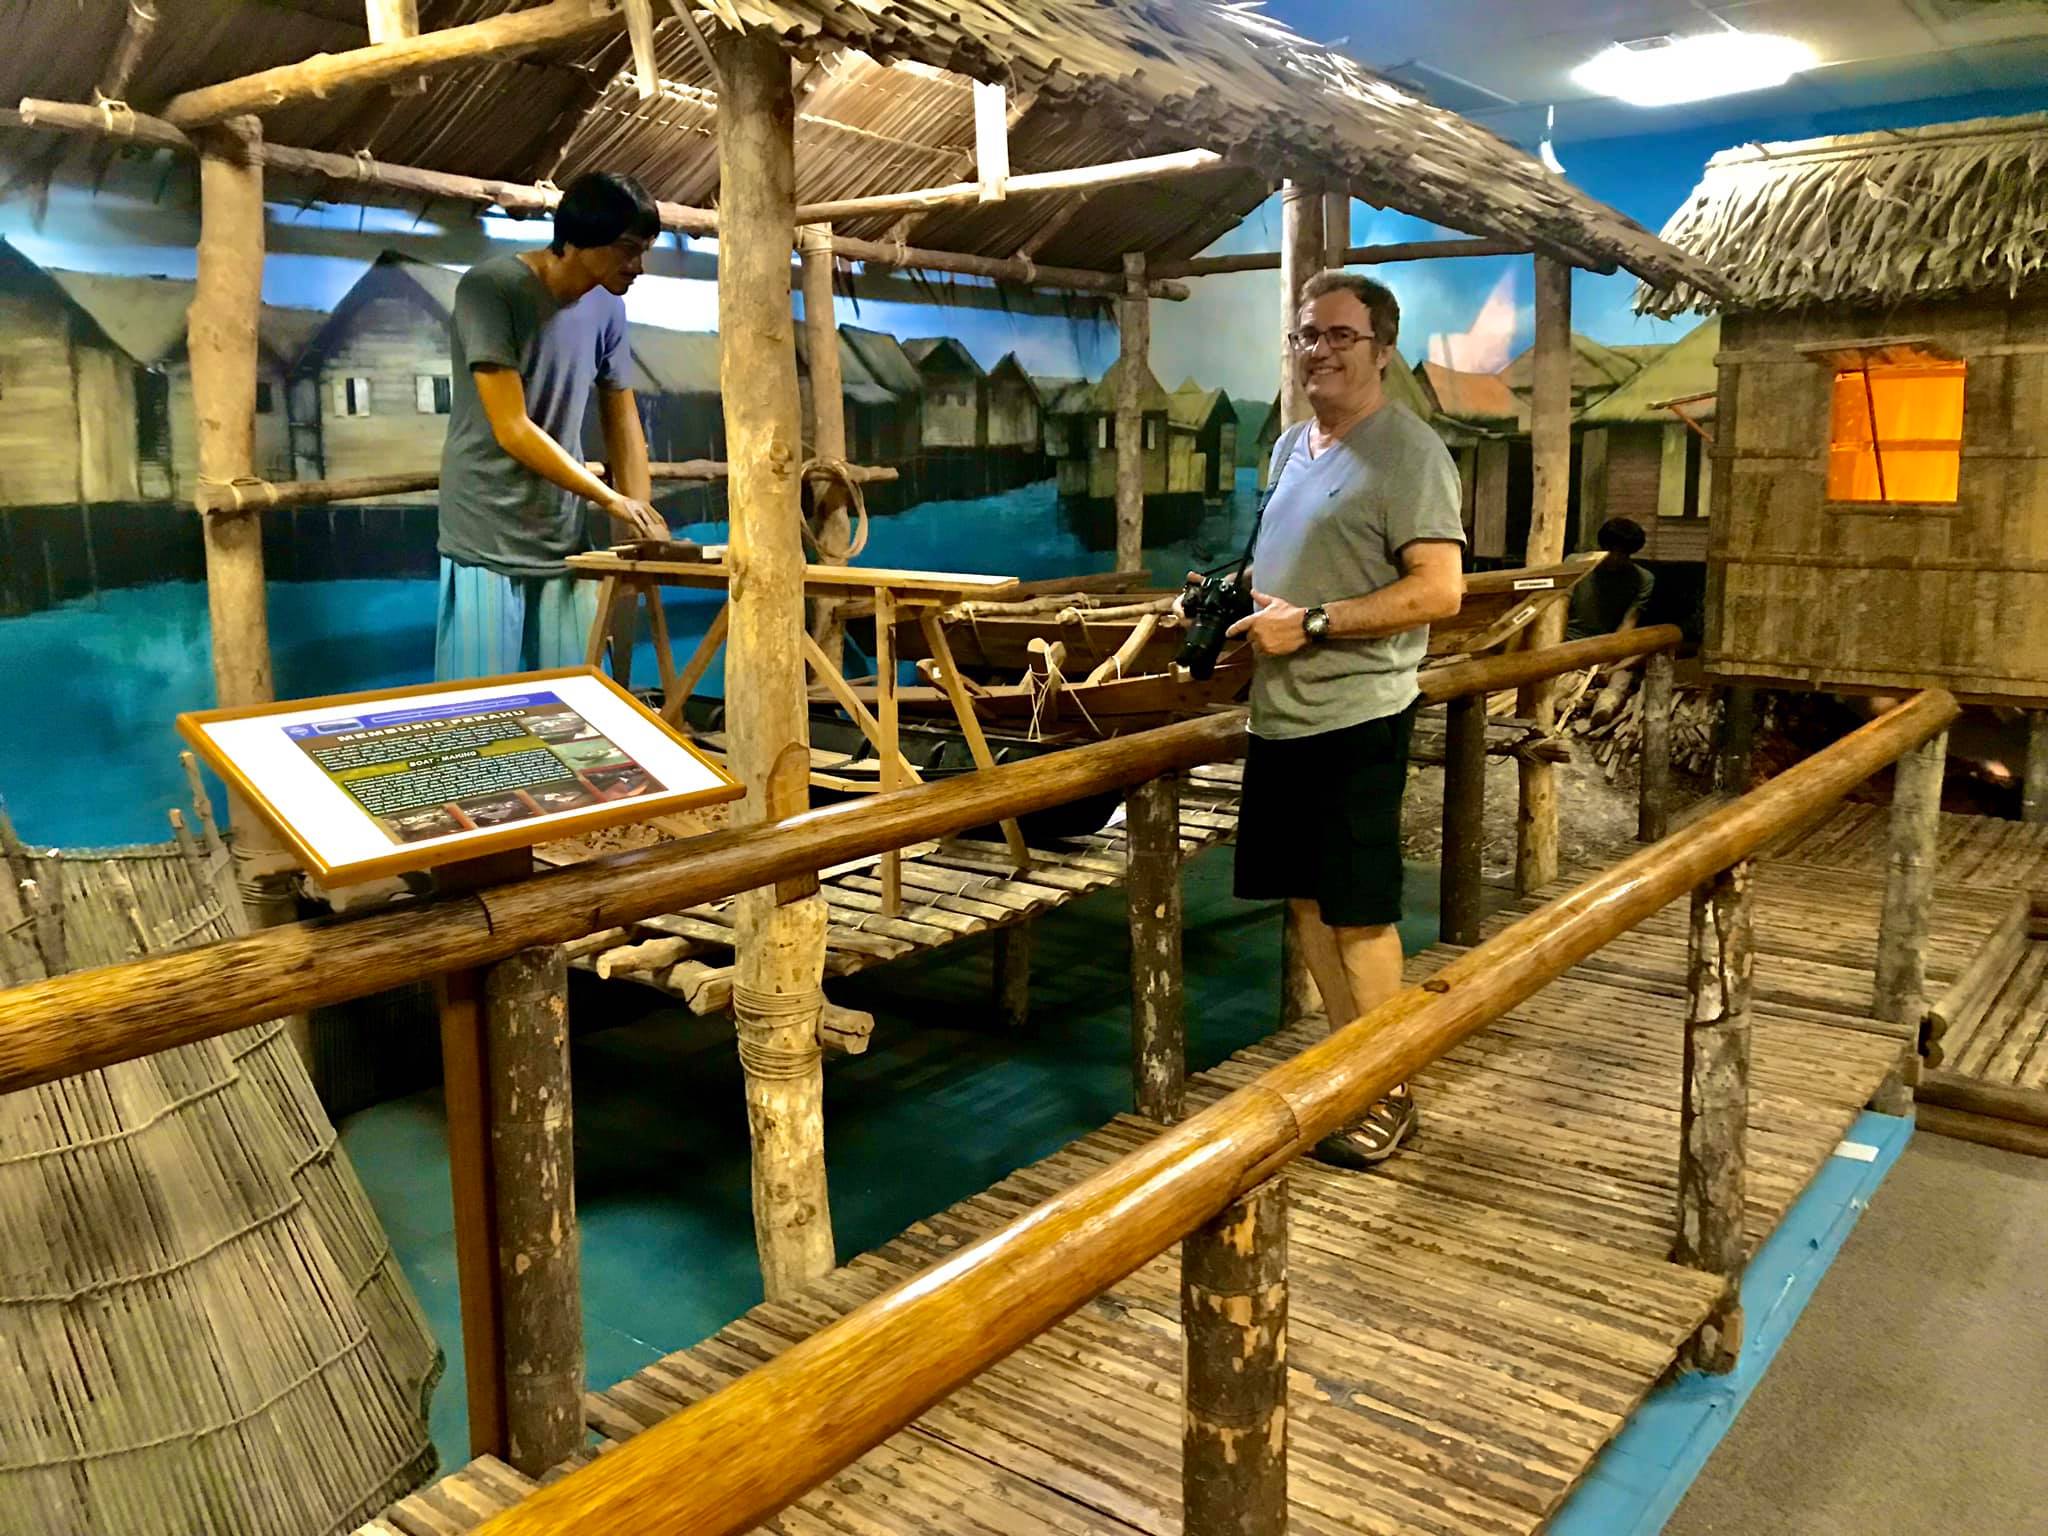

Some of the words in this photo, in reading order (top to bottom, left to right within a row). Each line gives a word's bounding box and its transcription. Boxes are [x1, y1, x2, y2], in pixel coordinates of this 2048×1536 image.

[450, 710, 526, 725] PERAHU
[408, 757, 434, 768] BOAT
[441, 751, 477, 761] MAKING
